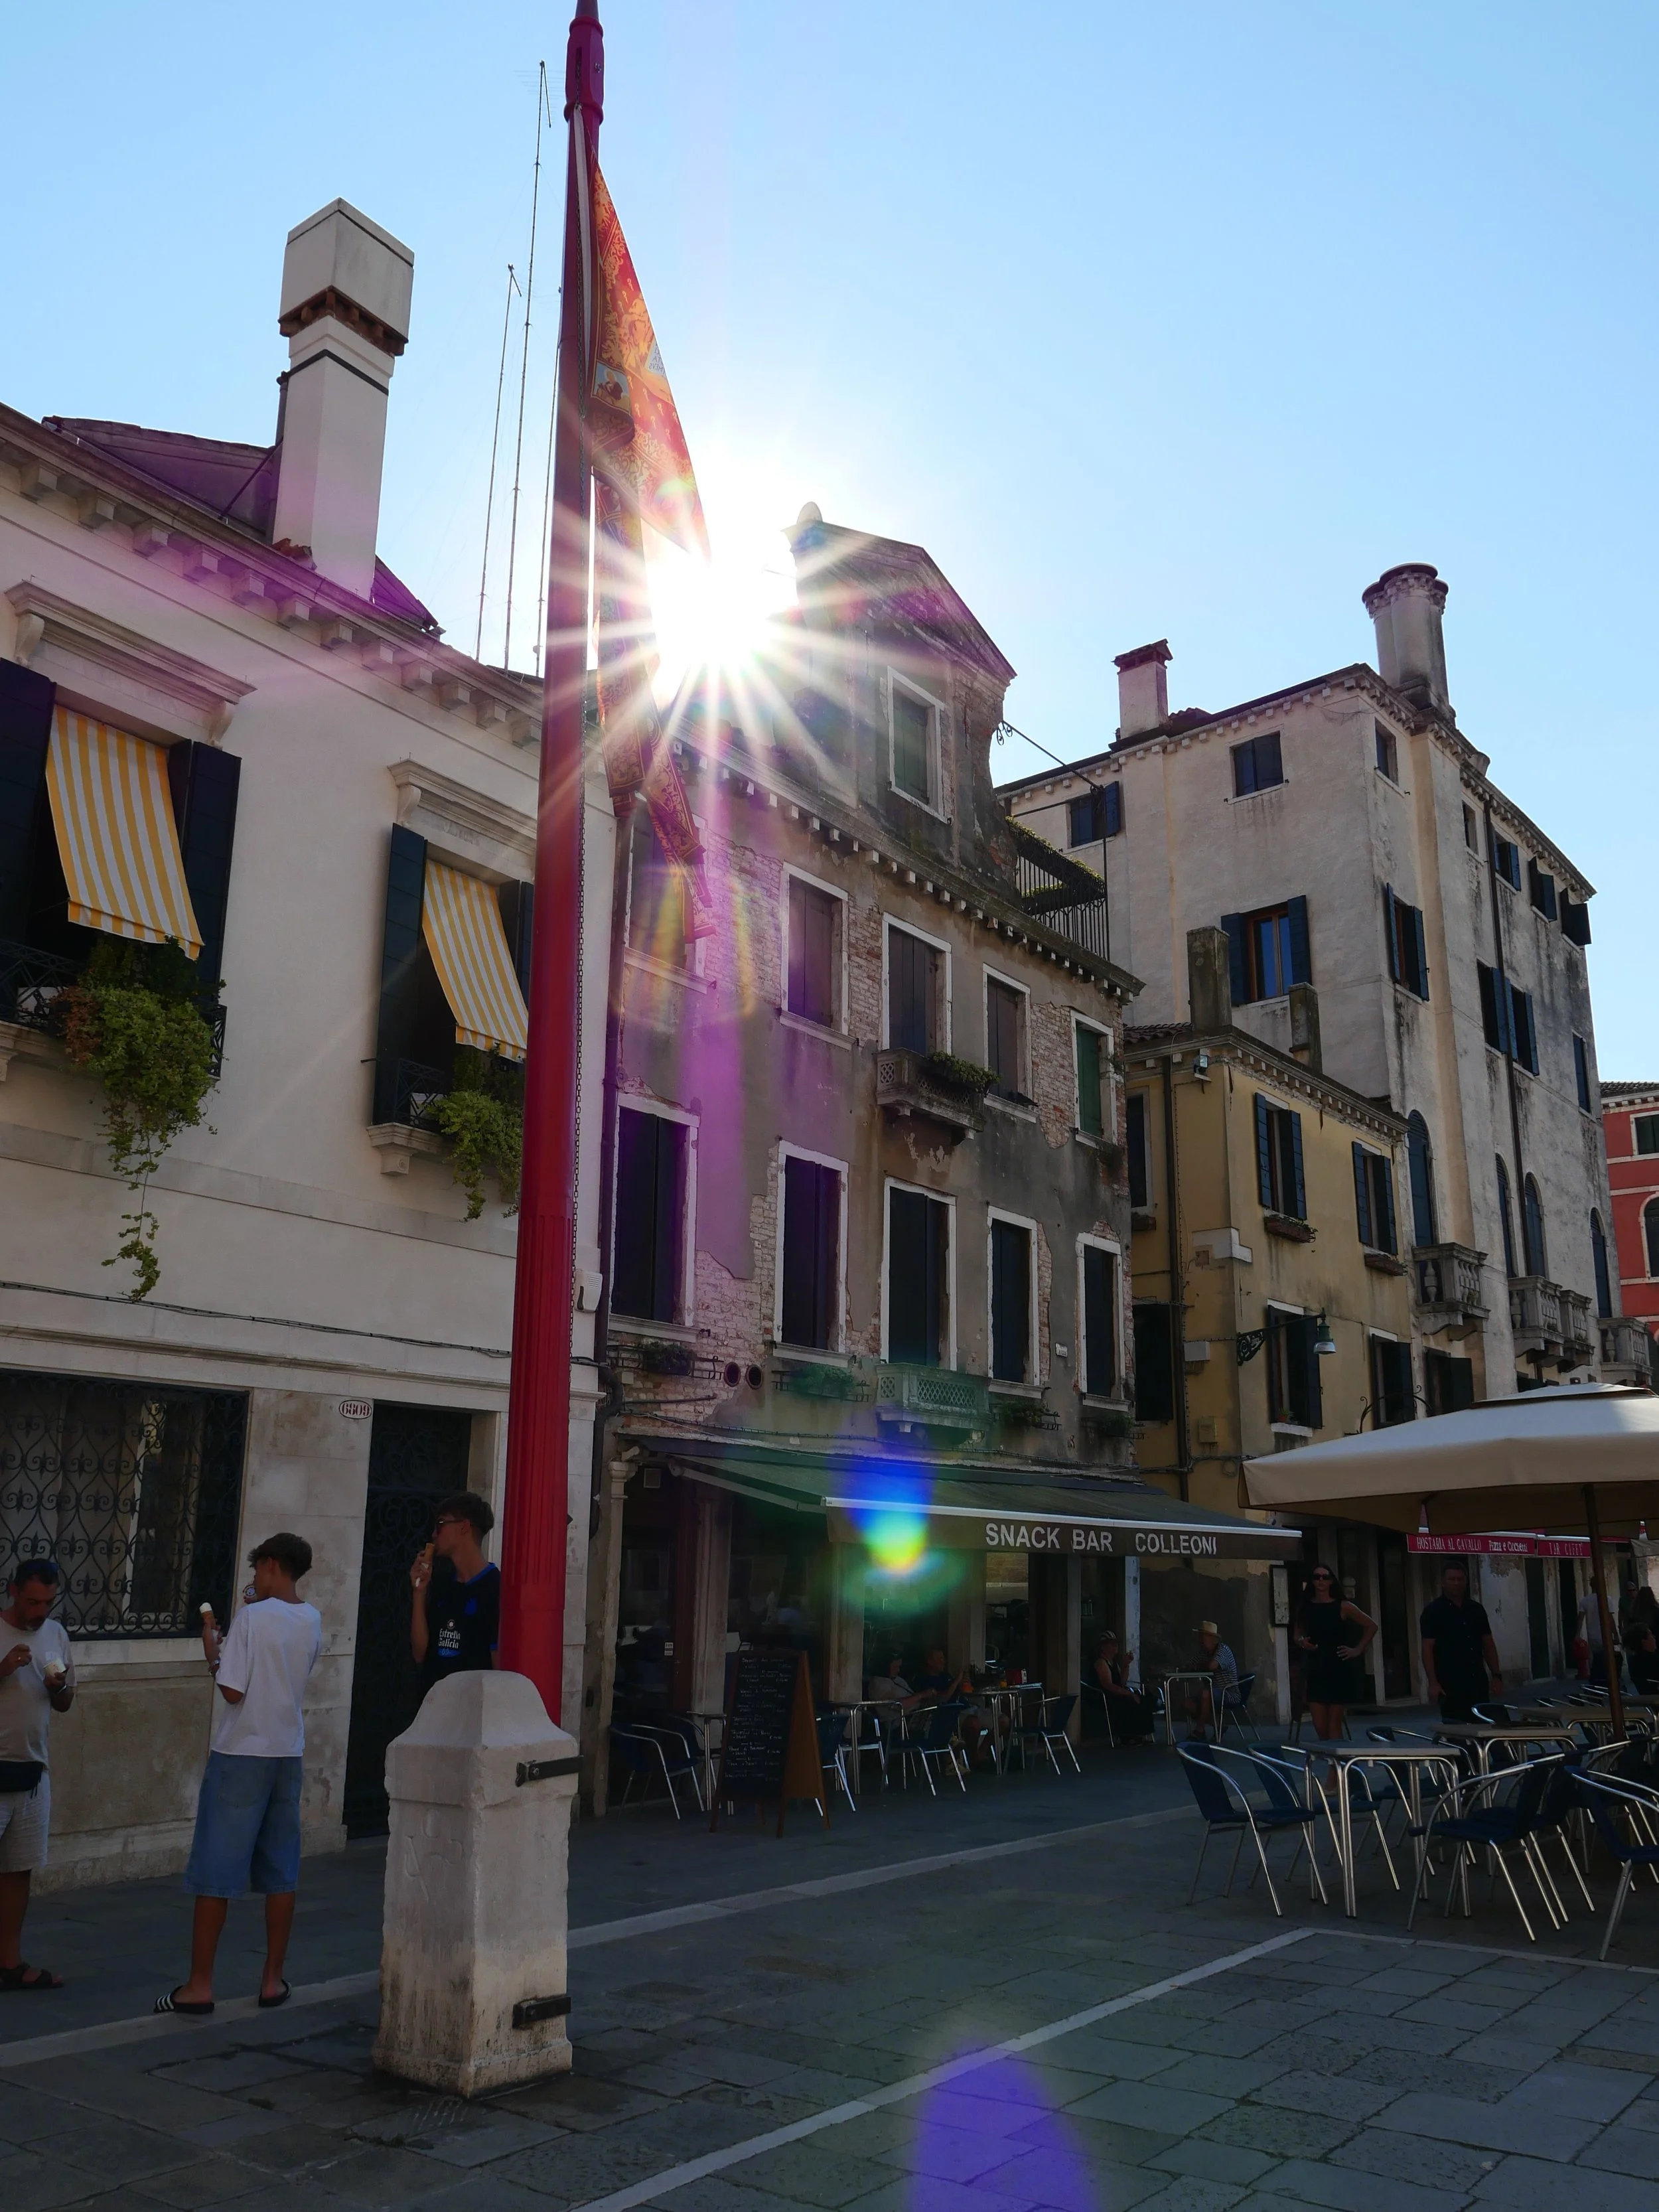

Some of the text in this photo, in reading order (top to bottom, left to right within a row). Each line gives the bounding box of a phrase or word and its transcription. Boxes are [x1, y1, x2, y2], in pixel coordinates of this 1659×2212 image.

[342, 1402, 370, 1416] 6809
[985, 1522, 1217, 1556] SNACK BAR COLLEONI
[1416, 1536, 1446, 1550] HOSTARIA
[1448, 1538, 1455, 1550] AL
[439, 1628, 461, 1640] Estrella
[438, 1637, 459, 1649] Galicia
